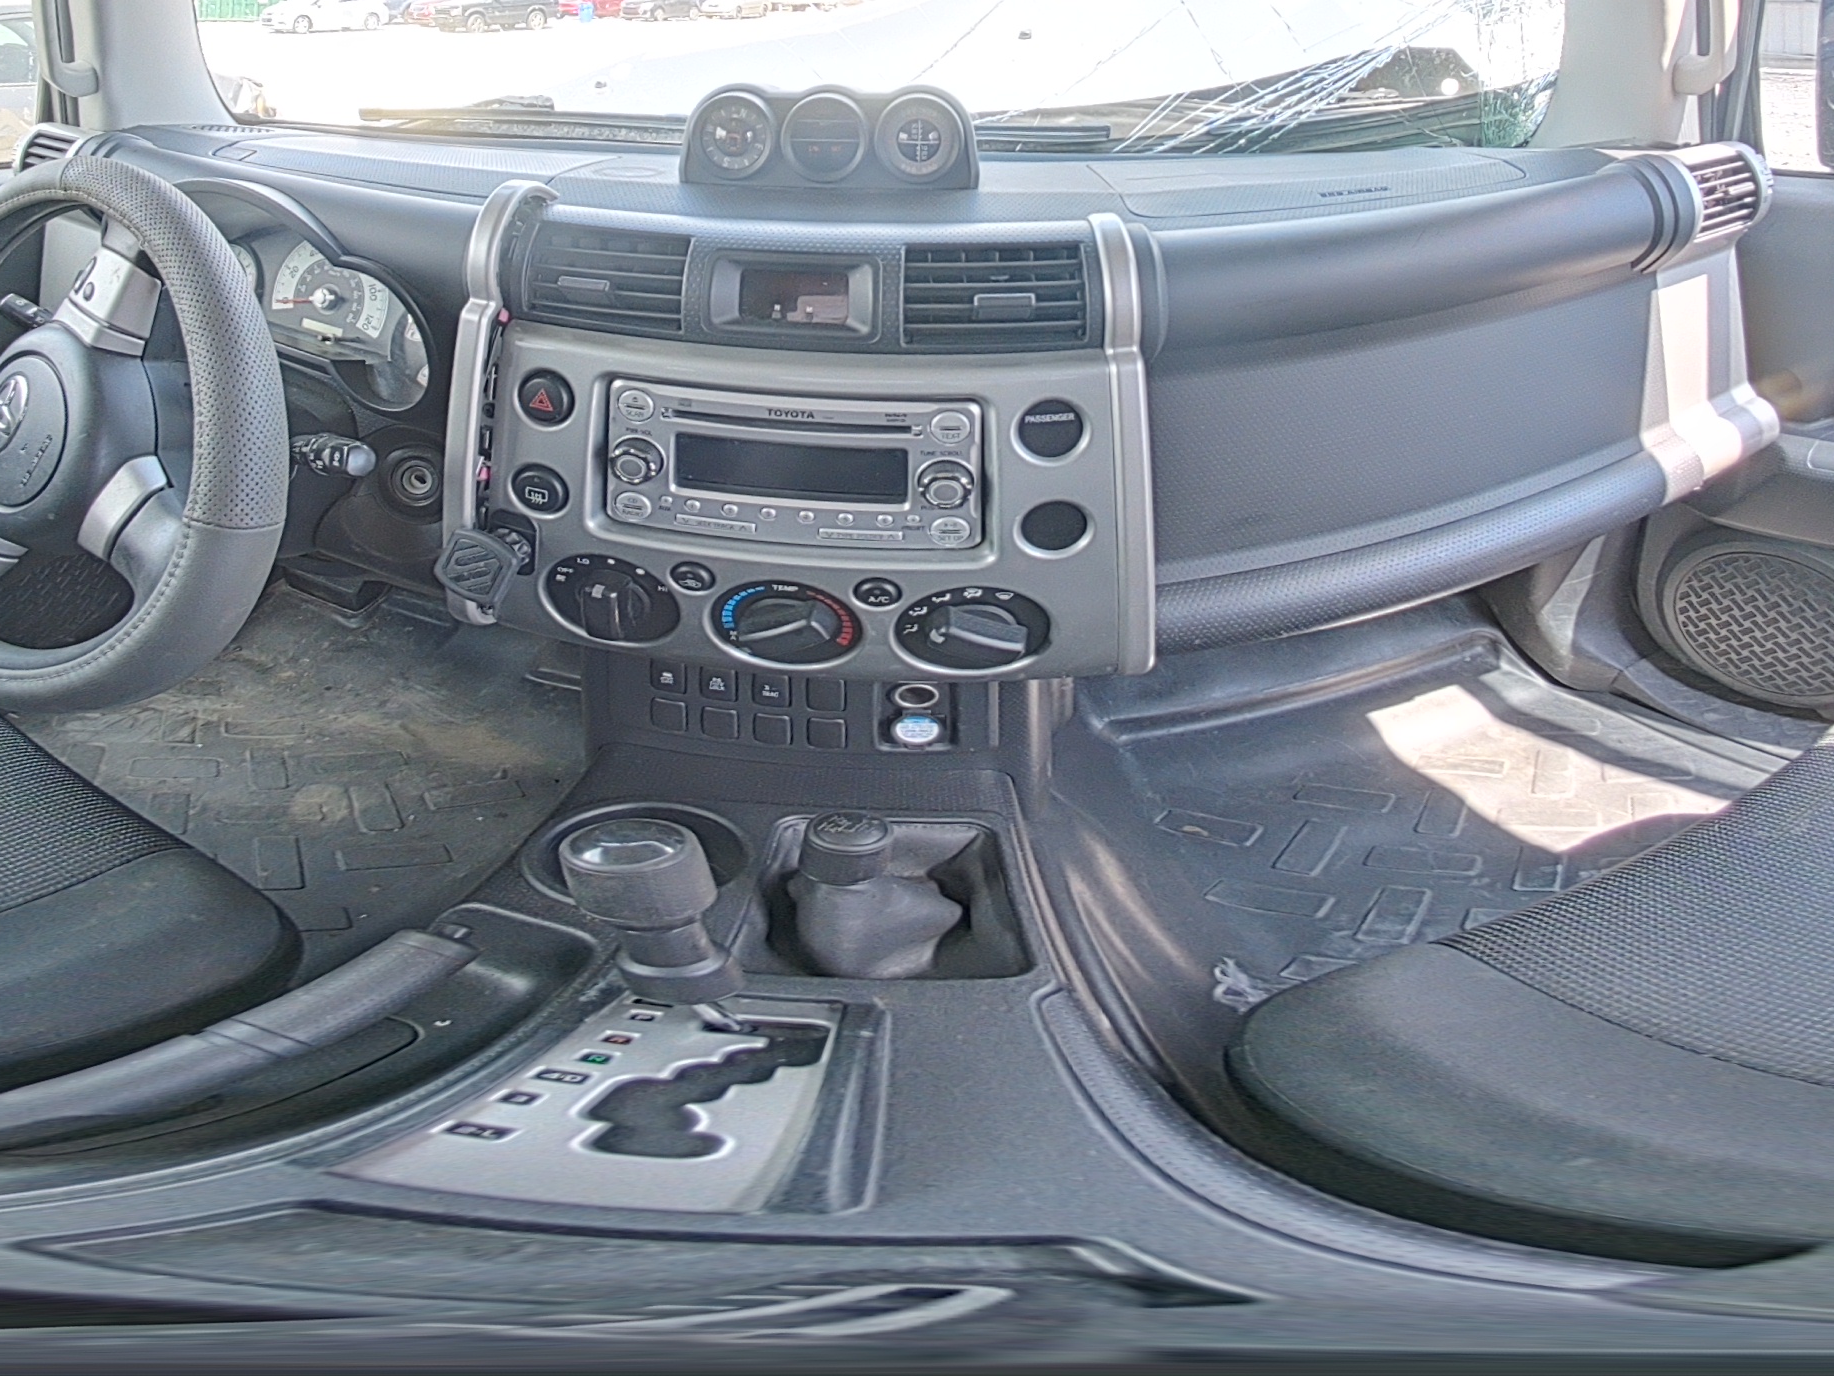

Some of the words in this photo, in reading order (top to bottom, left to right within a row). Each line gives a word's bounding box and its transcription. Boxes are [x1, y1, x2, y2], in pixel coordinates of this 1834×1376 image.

[288, 265, 300, 279] 20
[368, 283, 378, 302] 100
[362, 314, 373, 331] 120
[767, 408, 815, 420] TOYOTA
[1025, 412, 1075, 424] PASSENGER
[576, 557, 590, 565] LO
[771, 584, 799, 592] TEMP
[868, 595, 891, 603] A/C
